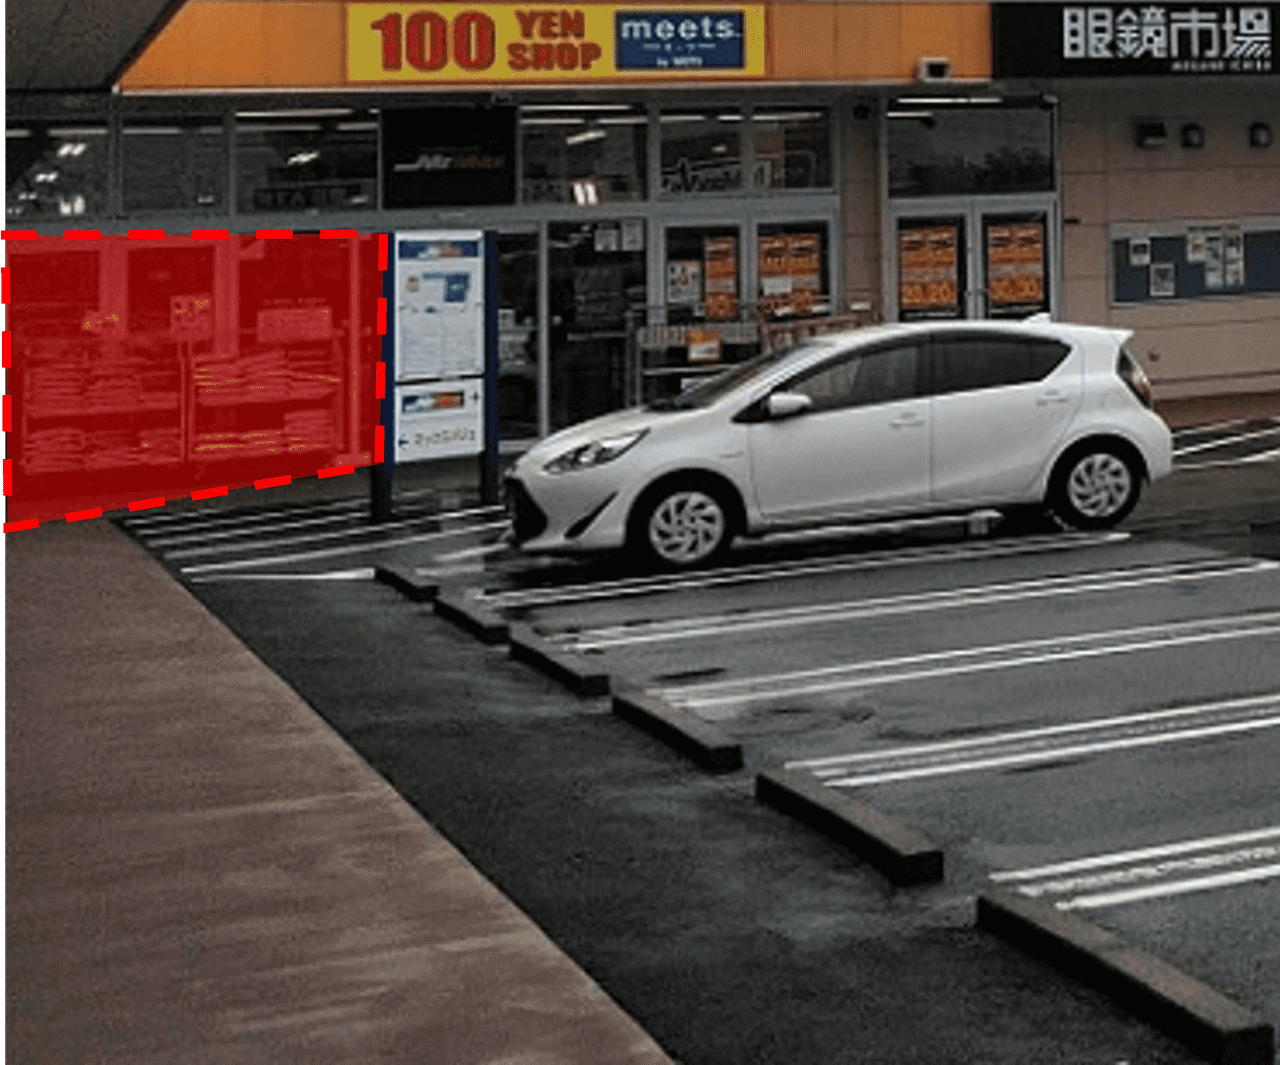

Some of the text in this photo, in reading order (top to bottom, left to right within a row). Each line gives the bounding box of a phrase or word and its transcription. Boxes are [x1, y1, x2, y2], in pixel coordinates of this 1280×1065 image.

[370, 9, 497, 72] 100
[513, 9, 587, 40] YEN
[1062, 6, 1272, 59] 眼鏡市場
[506, 42, 603, 71] SHOP
